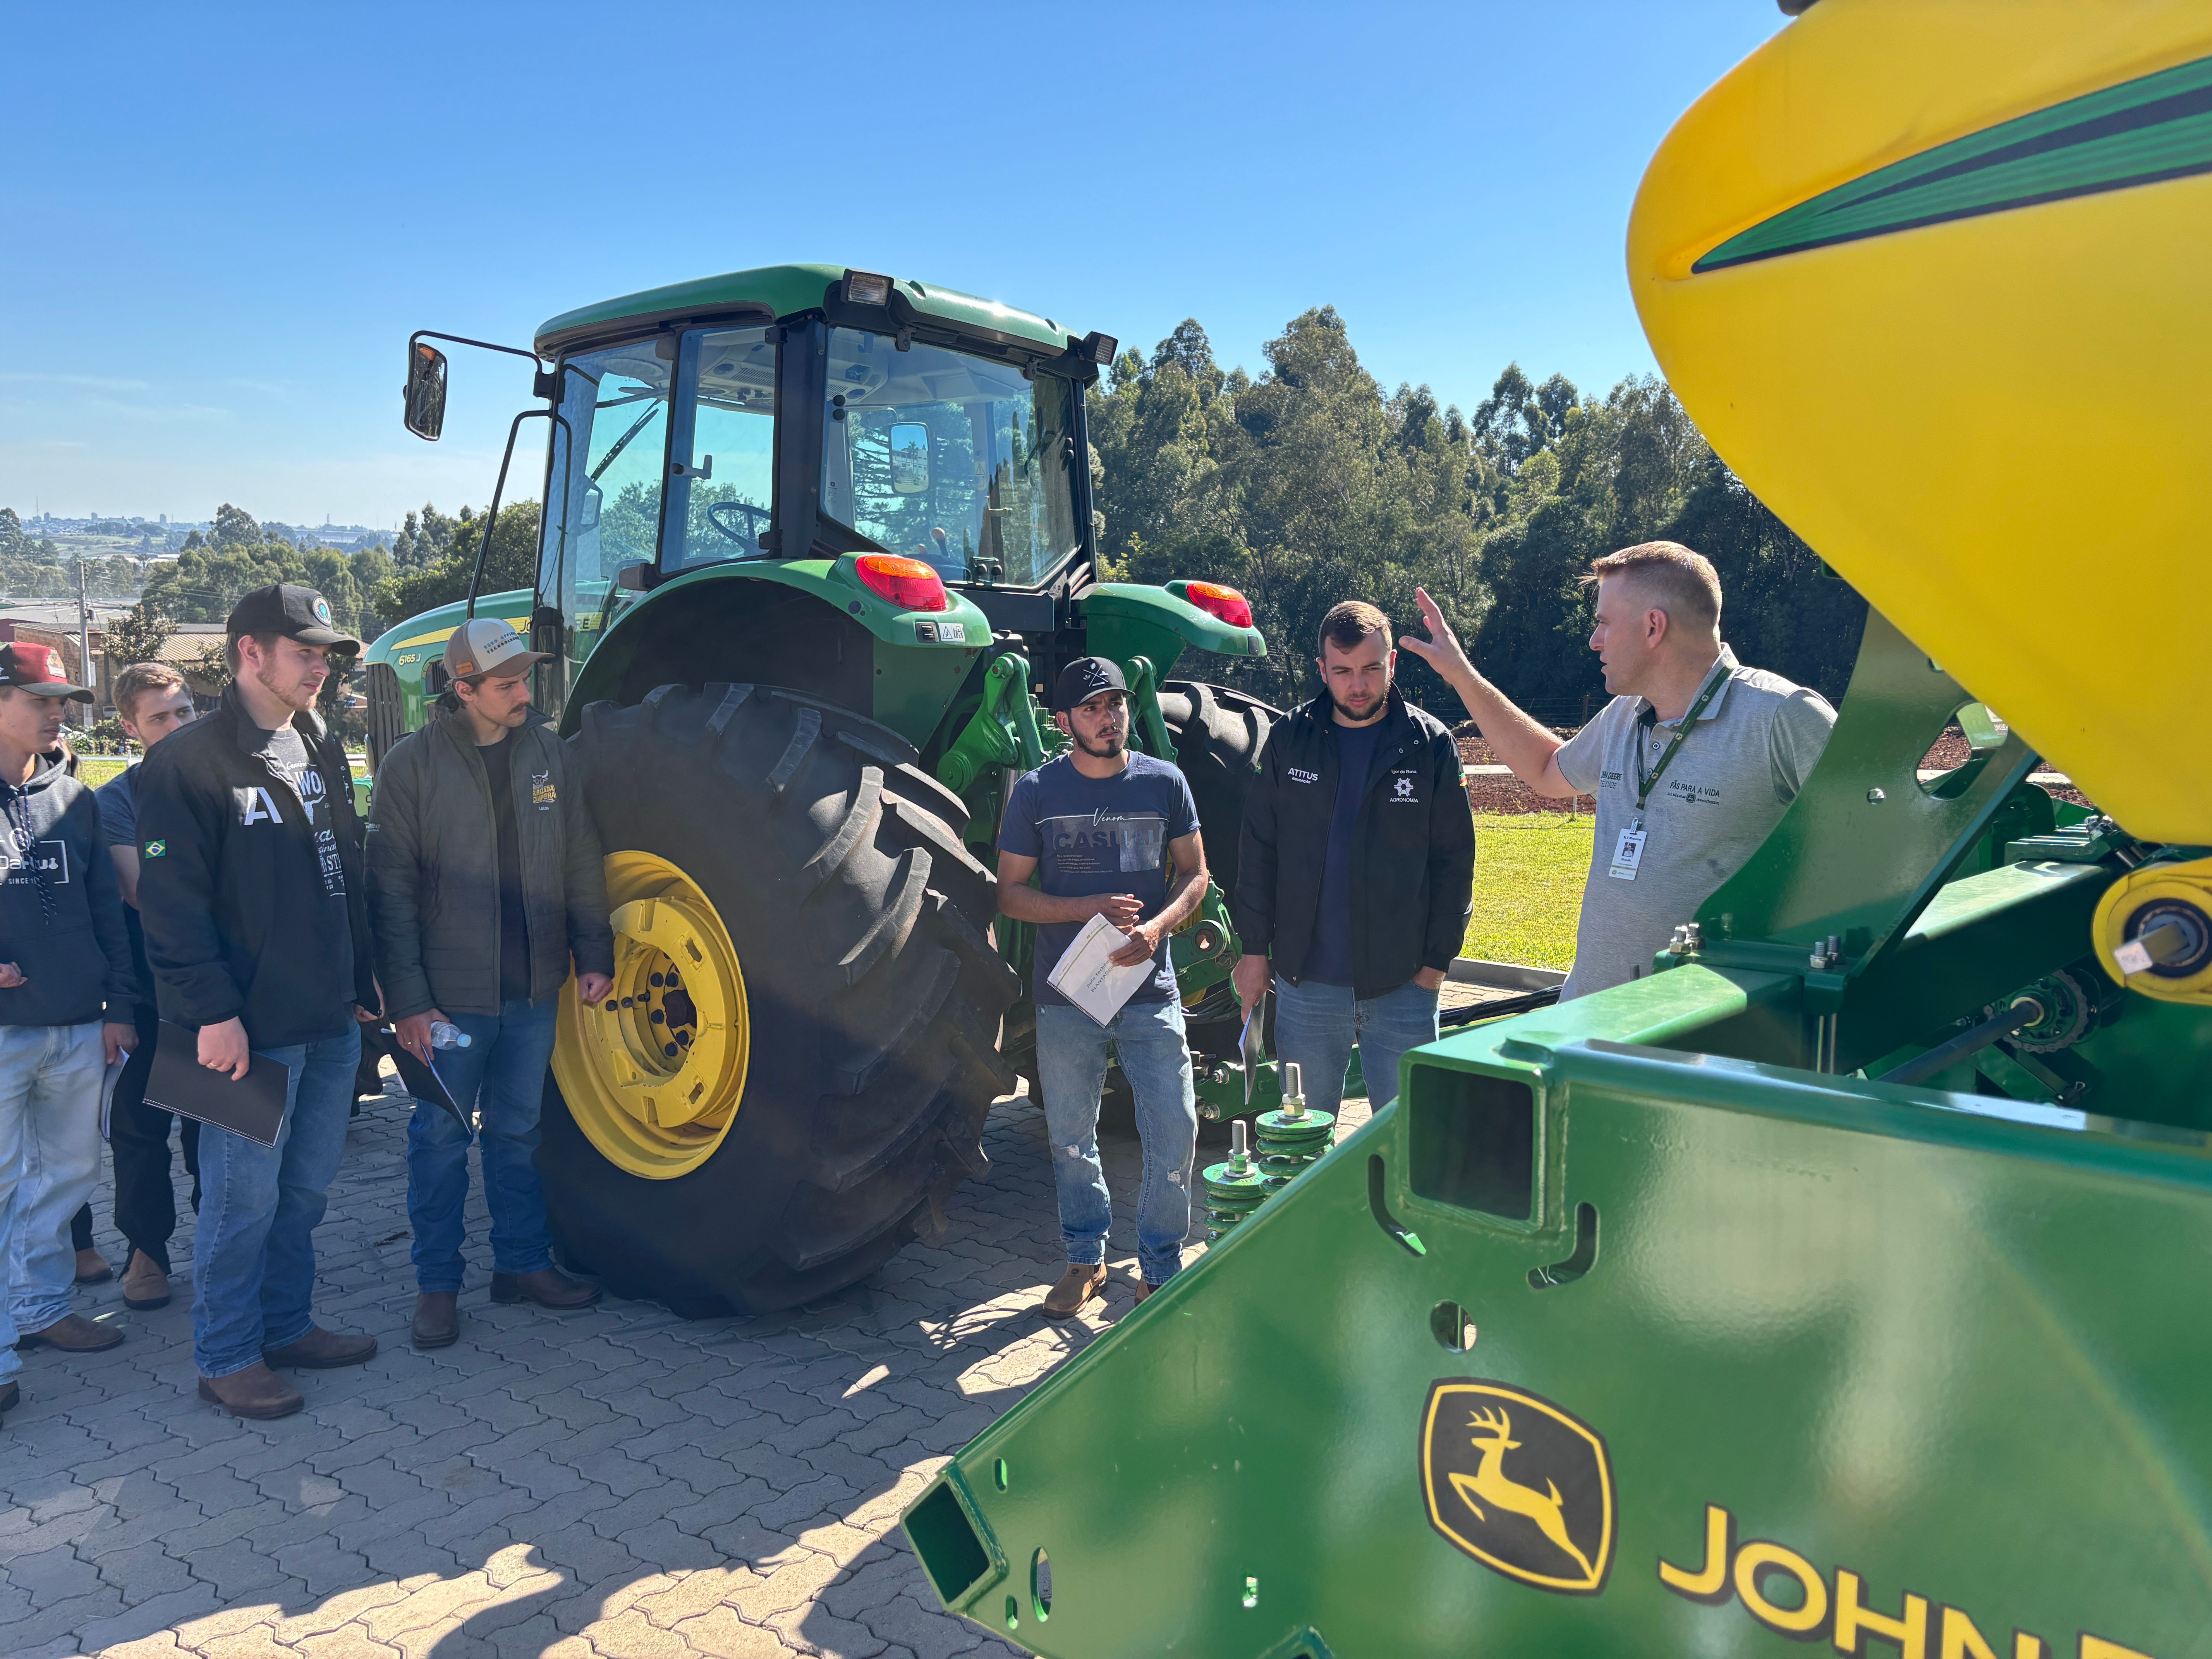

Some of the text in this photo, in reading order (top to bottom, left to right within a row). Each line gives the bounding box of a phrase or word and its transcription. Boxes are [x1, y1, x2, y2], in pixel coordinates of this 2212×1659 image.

[399, 653, 421, 666] 6165 J
[286, 760, 307, 771] Genuine
[1288, 768, 1318, 781] ATITUS
[1680, 784, 1696, 793] PARA
[1705, 787, 1720, 797] VIDA
[1093, 807, 1125, 827] Venom
[1054, 830, 1159, 848] CASUAL
